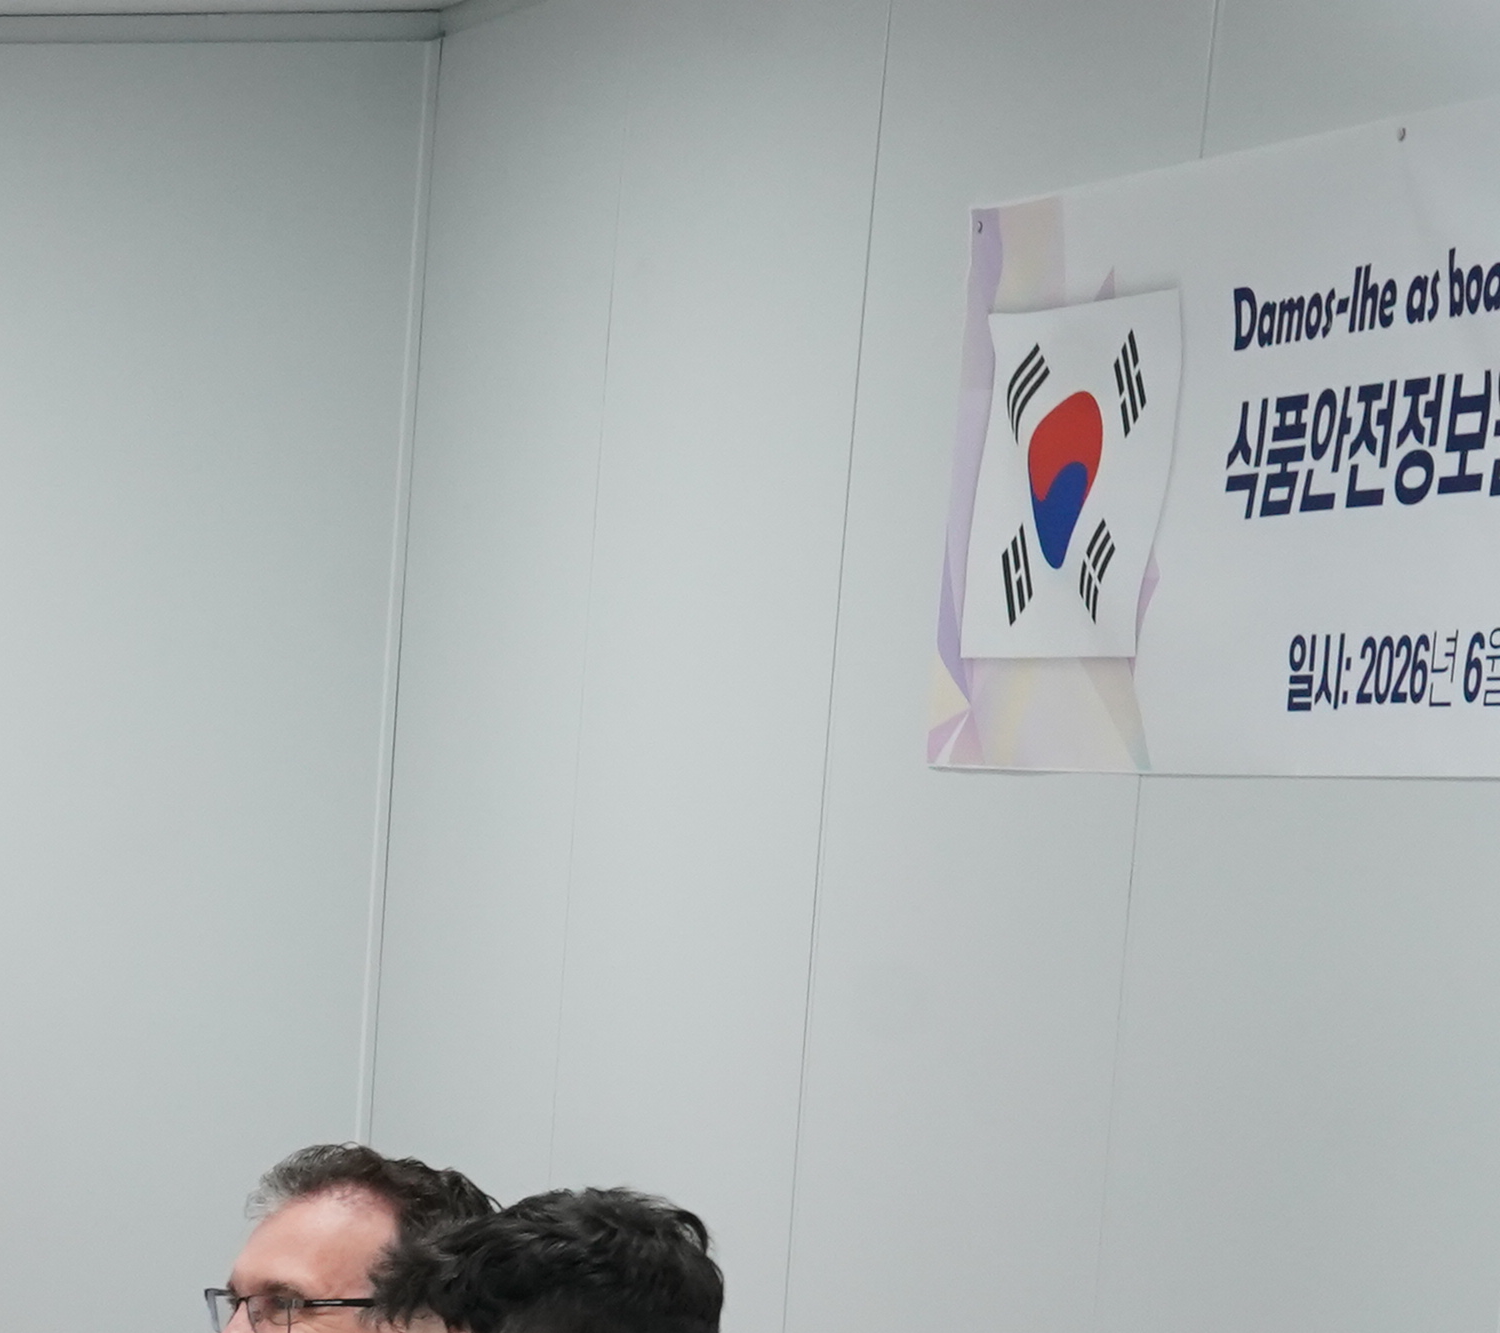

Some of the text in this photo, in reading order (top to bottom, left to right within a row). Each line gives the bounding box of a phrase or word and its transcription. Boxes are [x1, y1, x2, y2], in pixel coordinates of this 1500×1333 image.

[1234, 263, 1398, 352] Damos-lhe
[1405, 269, 1440, 326] as
[1225, 369, 1500, 520] 식품안전정보
[1287, 632, 1352, 712] 일시:
[1355, 628, 1459, 708] 2026년
